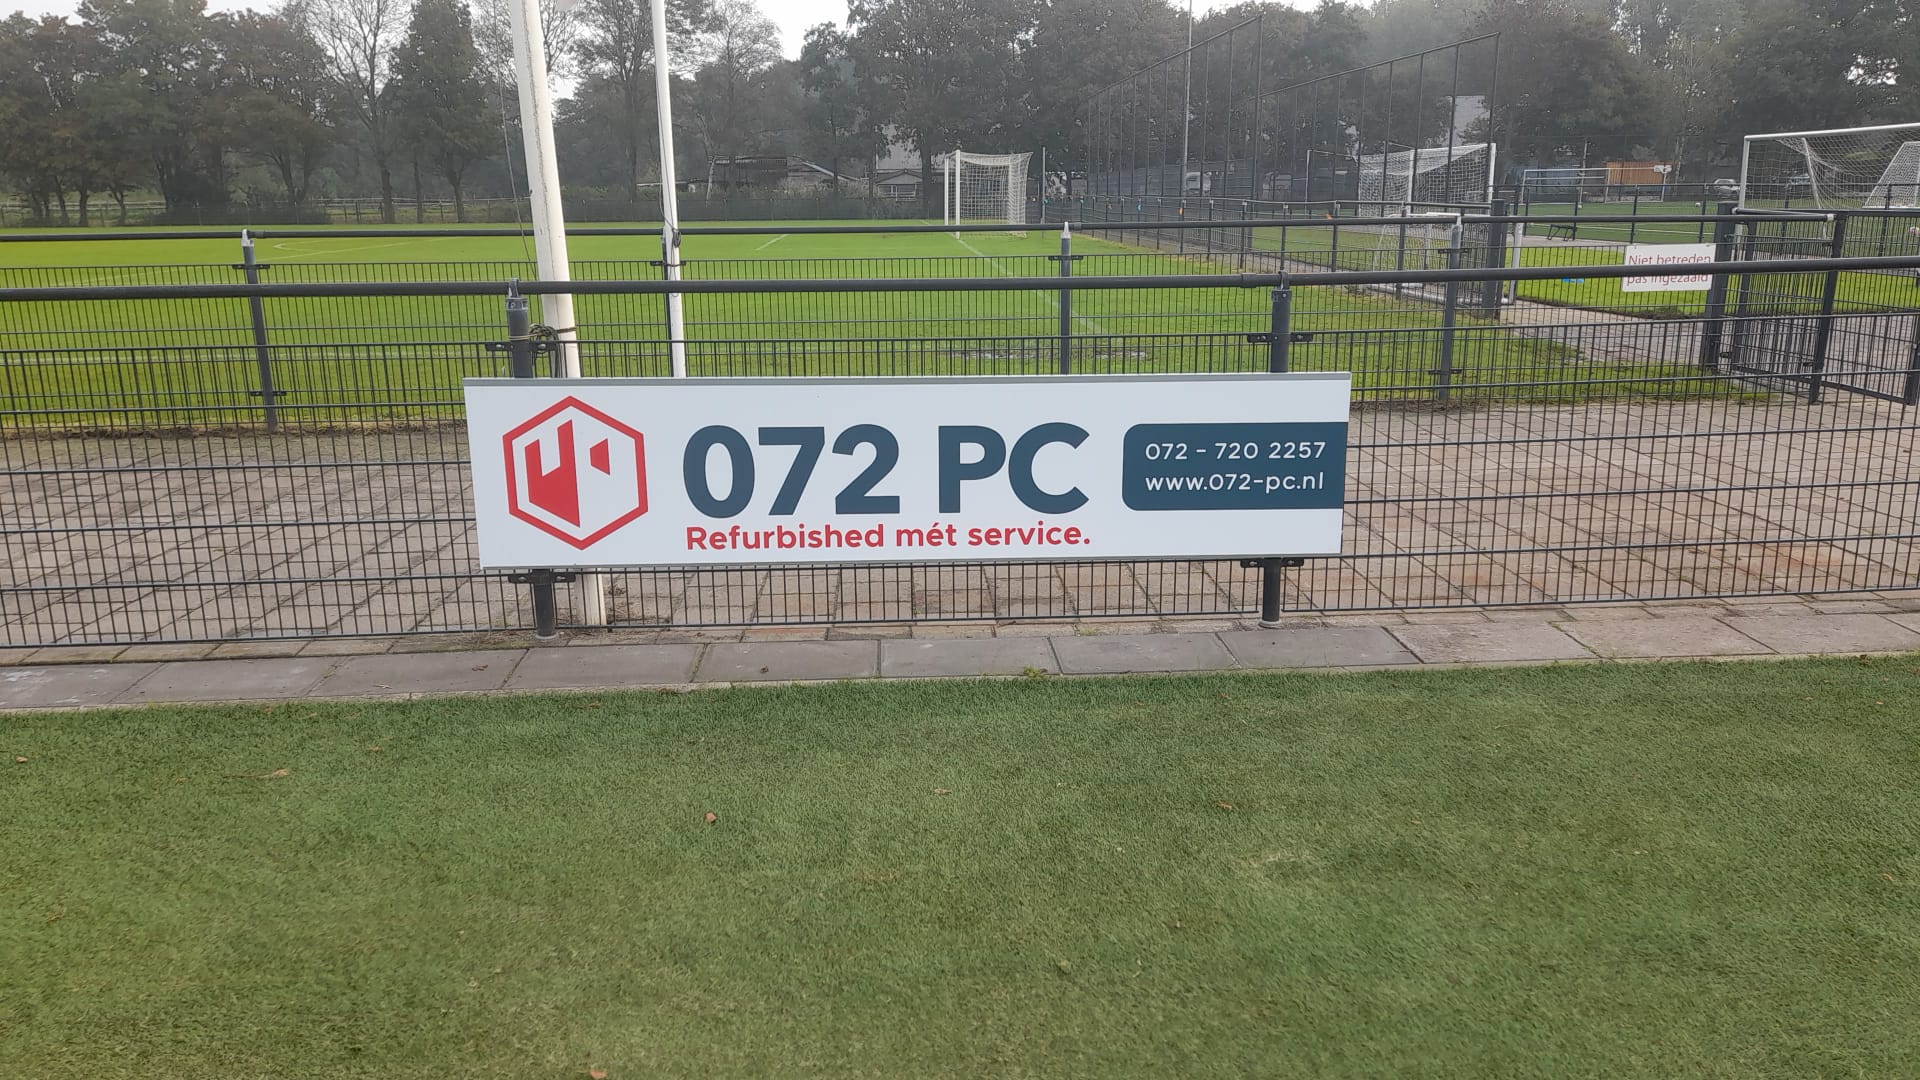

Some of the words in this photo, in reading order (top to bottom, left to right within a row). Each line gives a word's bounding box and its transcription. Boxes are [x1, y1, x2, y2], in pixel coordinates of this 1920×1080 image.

[1629, 255, 1653, 265] Niet
[1656, 253, 1712, 264] betreden
[1626, 276, 1648, 287] pas
[1145, 442, 1188, 461] 072
[1214, 442, 1259, 460] 720
[1269, 441, 1326, 459] 2257
[682, 423, 900, 519] 072
[938, 421, 1091, 515] PC
[1145, 471, 1325, 494] www.072-pc.nl
[686, 523, 884, 551] Refurbished
[896, 521, 958, 548] mét
[967, 520, 1091, 546] service.
